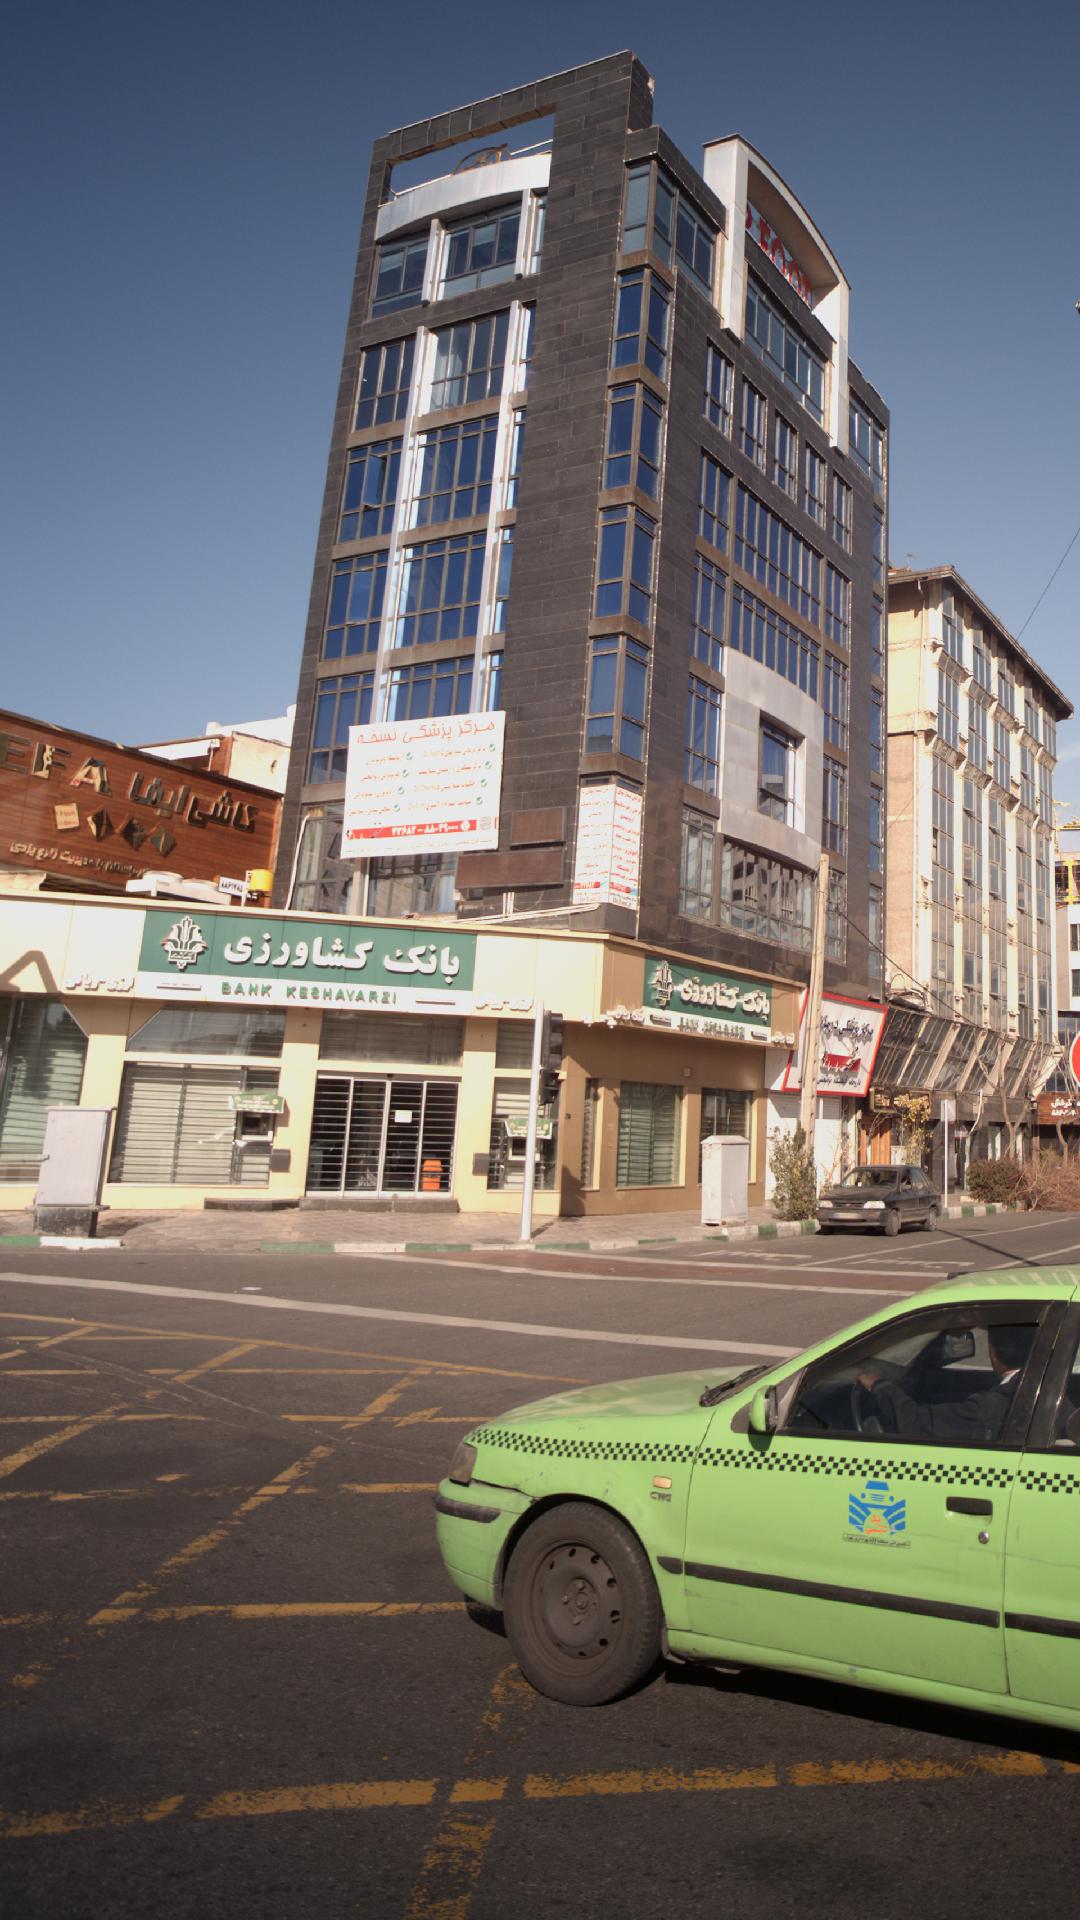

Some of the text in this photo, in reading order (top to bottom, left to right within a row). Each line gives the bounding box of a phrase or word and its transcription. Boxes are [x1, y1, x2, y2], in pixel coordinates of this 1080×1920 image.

[223, 931, 461, 984] بانک کشاورزی
[221, 981, 273, 998] BANK
